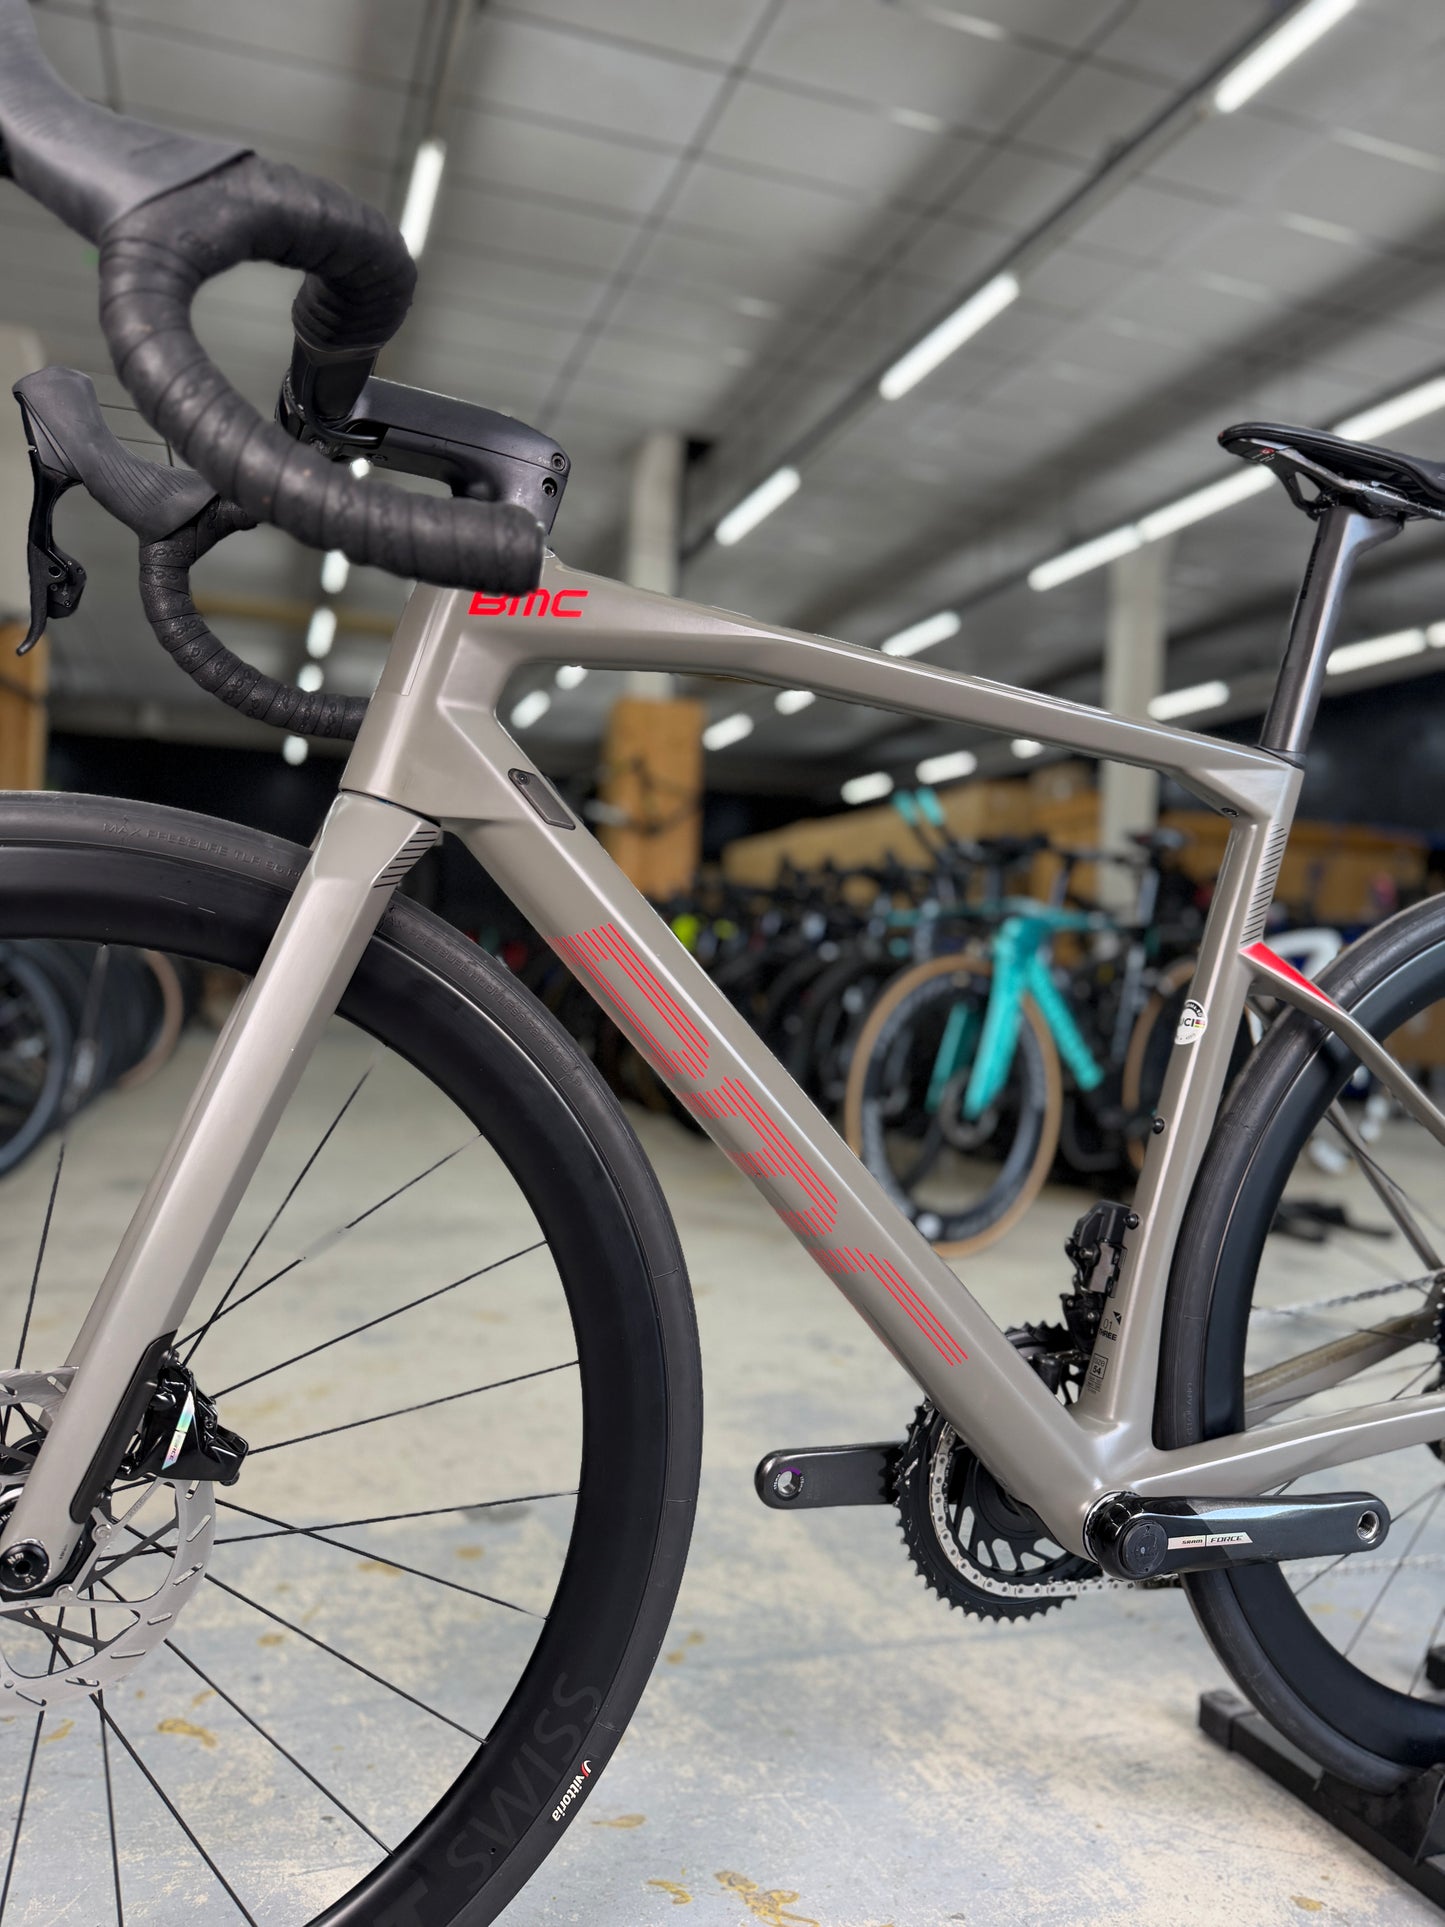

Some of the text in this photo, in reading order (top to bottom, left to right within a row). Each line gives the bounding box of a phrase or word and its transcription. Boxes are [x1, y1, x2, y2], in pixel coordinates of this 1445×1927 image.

[1093, 1365, 1102, 1375] 54
[1210, 1535, 1244, 1543] FORCE
[447, 1672, 601, 1887] SWISS
[551, 1774, 585, 1822] vittoria
